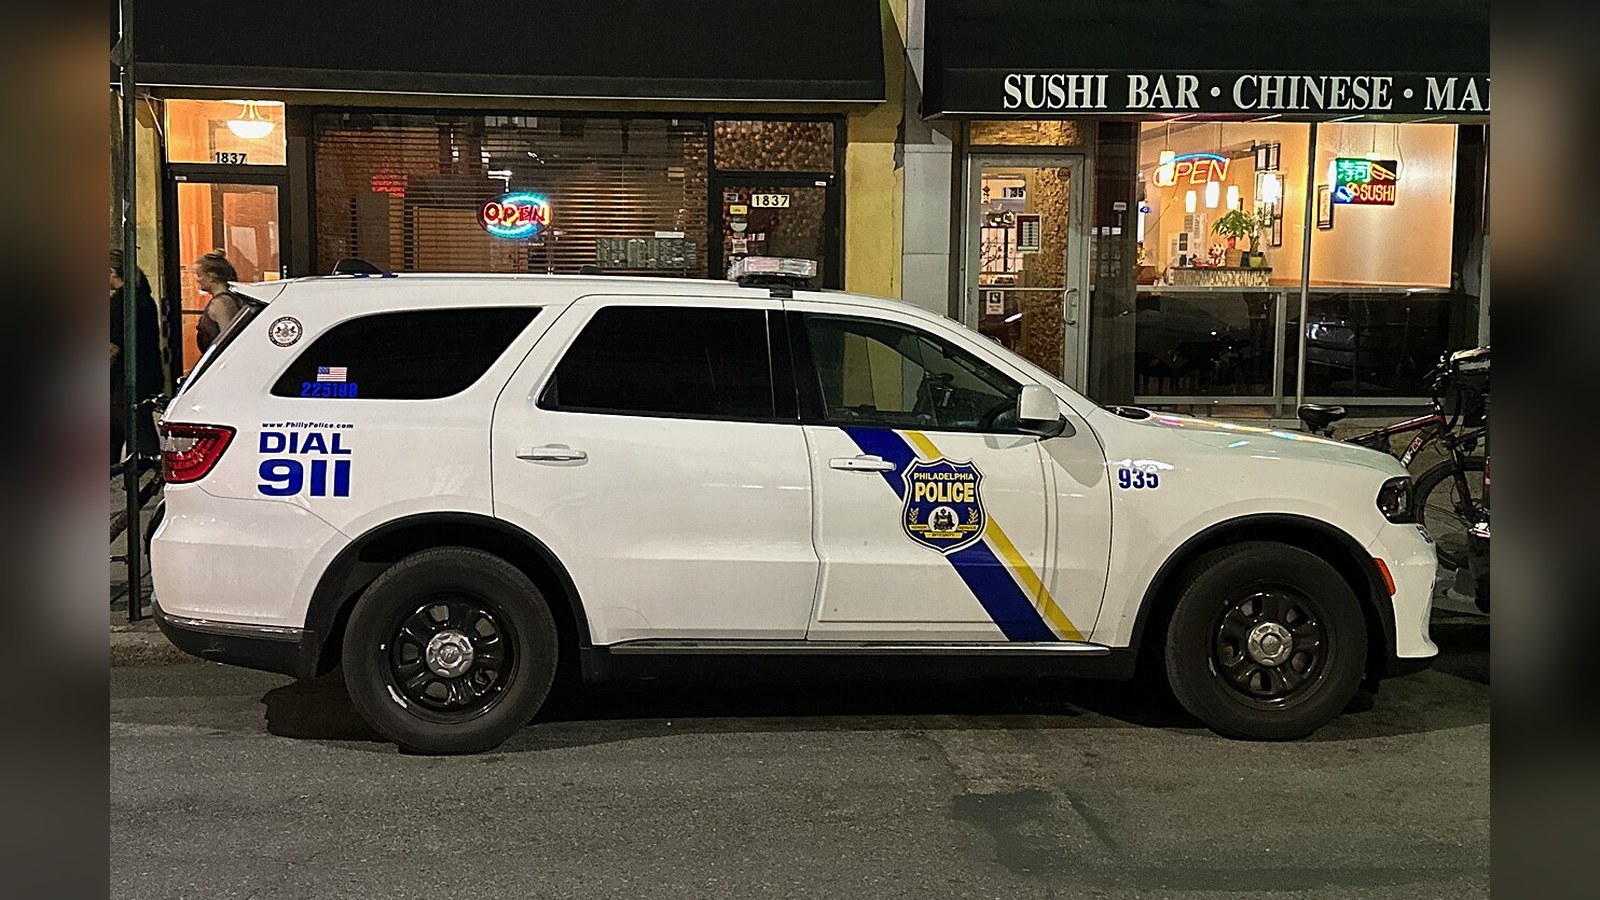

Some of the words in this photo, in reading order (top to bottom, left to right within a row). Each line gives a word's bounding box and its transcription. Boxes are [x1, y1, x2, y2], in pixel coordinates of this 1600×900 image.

[1003, 74, 1109, 109] SUSHI
[1126, 74, 1200, 109] BAR
[1232, 74, 1394, 110] CHINESE
[1424, 77, 1490, 111] MA
[215, 151, 247, 166] 1837
[1153, 158, 1230, 187] OPEN
[1337, 160, 1372, 183] 寿司
[754, 195, 789, 207] 1837
[1360, 184, 1395, 202] SUSHI
[483, 201, 551, 227] OPEN
[262, 422, 354, 430] www.PhillyPolice.com
[259, 431, 352, 454] DIAL
[257, 458, 351, 497] 911
[913, 472, 975, 480] PHILADELPHIA
[1118, 467, 1159, 489] 935
[914, 481, 974, 503] POLICE
